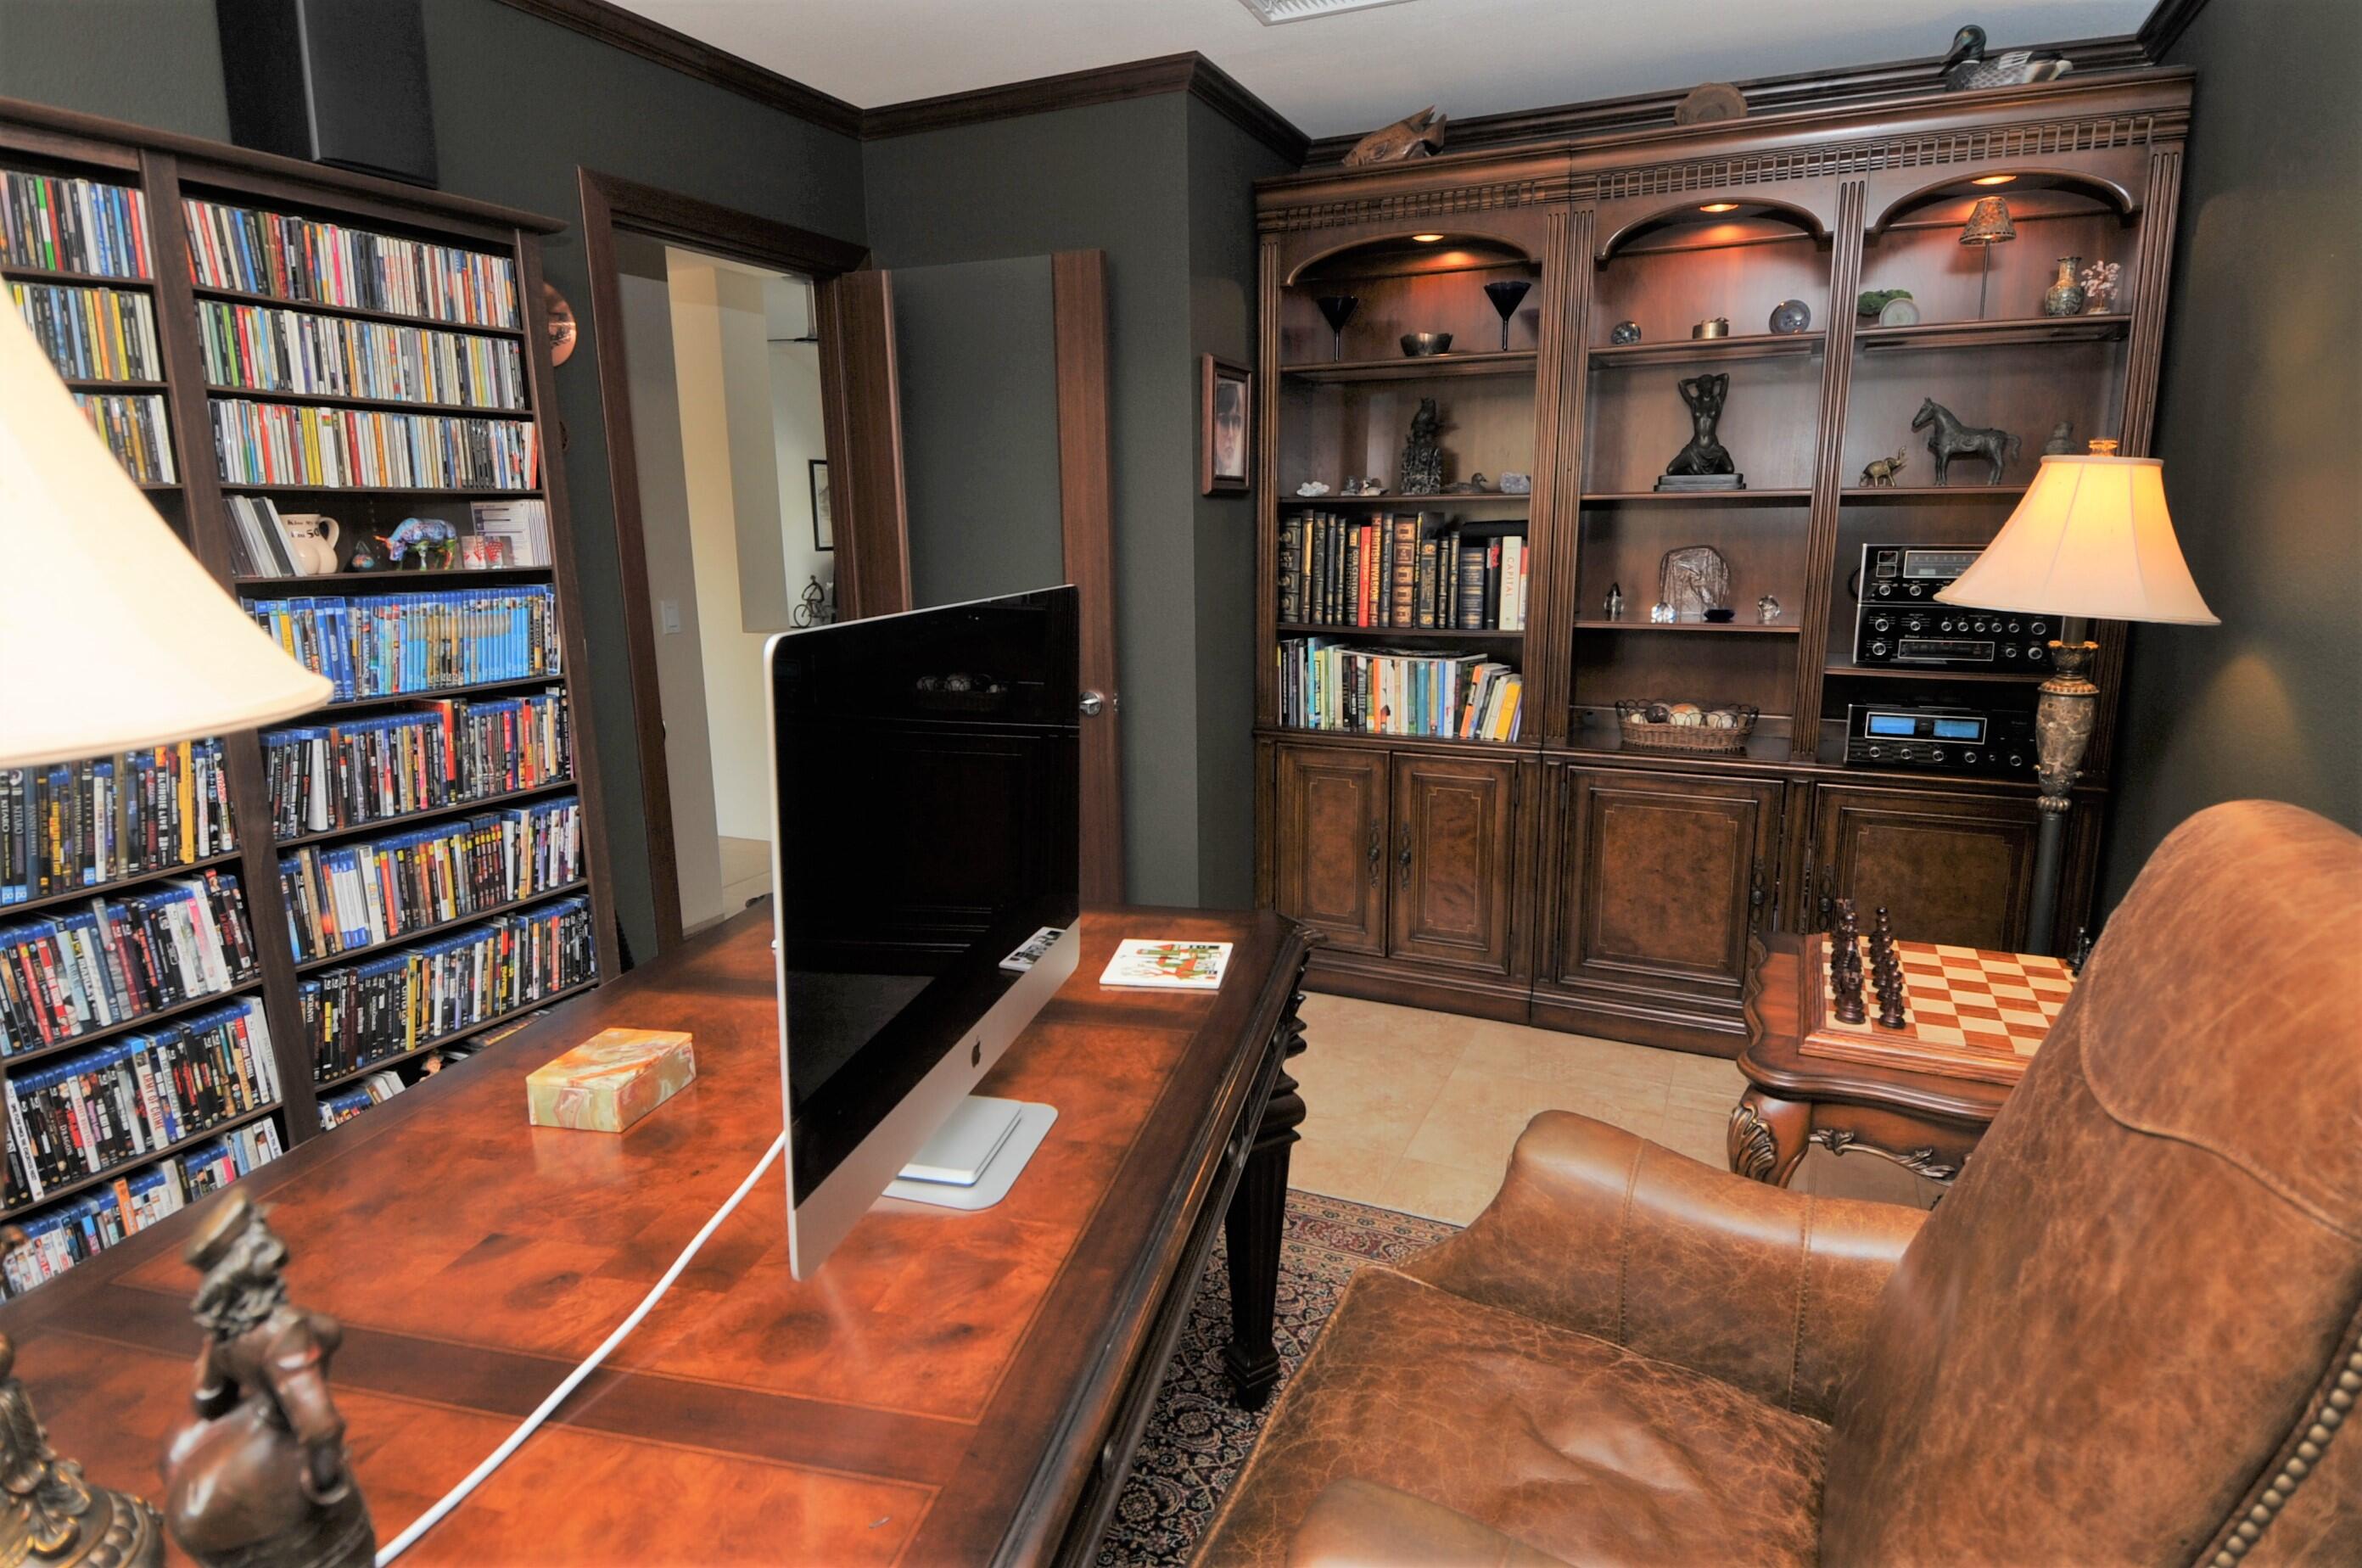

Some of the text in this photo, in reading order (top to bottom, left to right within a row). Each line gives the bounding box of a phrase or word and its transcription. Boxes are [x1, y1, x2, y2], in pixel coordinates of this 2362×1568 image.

[306, 528, 320, 539] 50
[1370, 563, 1380, 601] INVASION
[1505, 557, 1514, 597] CAPITAL
[1, 799, 10, 833] KITARO
[14, 804, 24, 835] KITARO
[158, 772, 169, 831] BLONDIE LIVE
[79, 959, 95, 1001] MARLEY
[142, 1073, 165, 1130] ARMY OF CRIME
[59, 1124, 73, 1156] DRAGON
